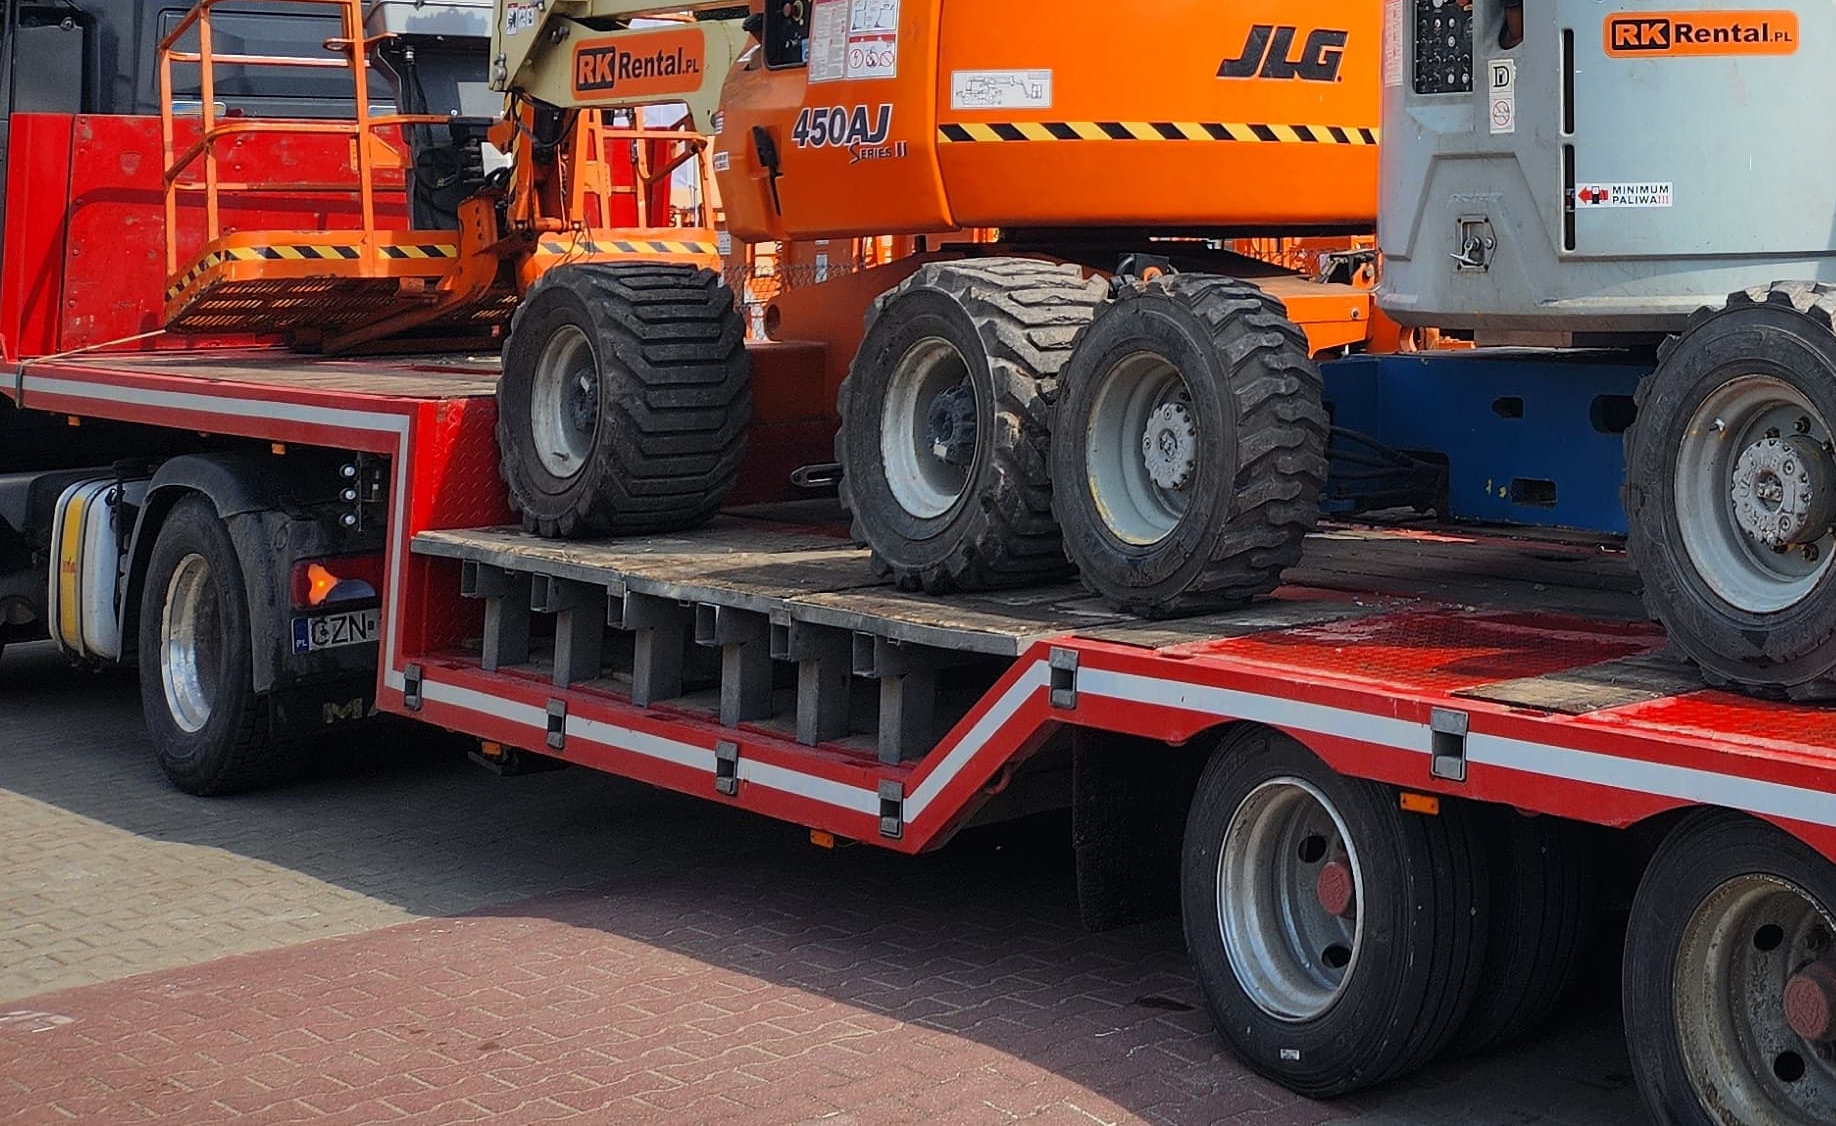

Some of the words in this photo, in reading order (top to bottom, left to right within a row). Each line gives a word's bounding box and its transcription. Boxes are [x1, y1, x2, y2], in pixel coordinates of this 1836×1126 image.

[1614, 22, 1668, 47] RK
[1675, 22, 1793, 44] Rental.PL
[577, 50, 615, 87] RK
[618, 46, 699, 80] Rental.PL
[1215, 23, 1348, 83] JLG
[791, 103, 894, 149] 450AJ
[1612, 185, 1669, 195] MINIMUM
[296, 639, 308, 648] PL
